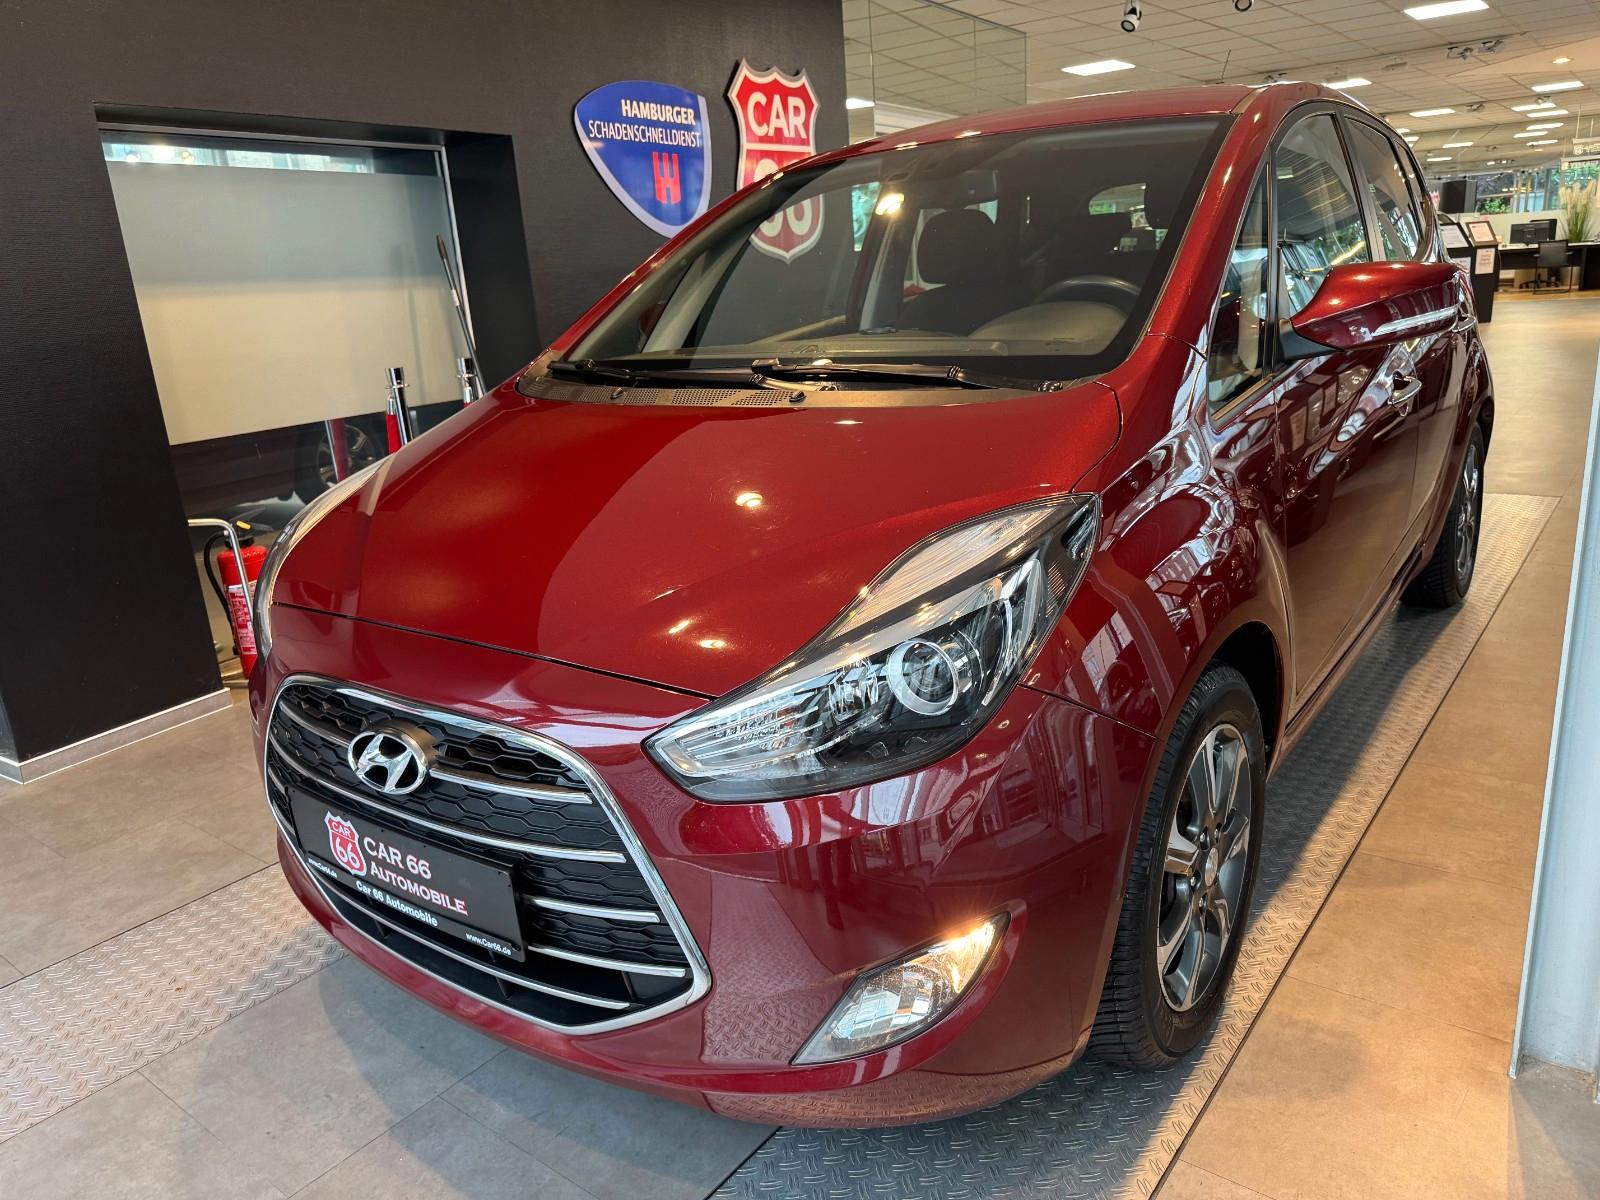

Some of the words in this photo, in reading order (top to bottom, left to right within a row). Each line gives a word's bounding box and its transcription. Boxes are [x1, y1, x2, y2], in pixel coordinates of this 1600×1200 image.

[621, 99, 696, 126] HAMBURGER
[747, 91, 807, 139] CAR
[588, 120, 701, 148] SCHADENSCHNELLDIENST
[332, 821, 352, 839] CAR
[335, 836, 361, 869] 66
[363, 837, 404, 870] CAR
[406, 854, 432, 880] 66
[355, 880, 372, 896] Car
[372, 888, 385, 902] 66
[386, 894, 439, 927] Automobile
[370, 861, 469, 917] AUTOMOBILE
